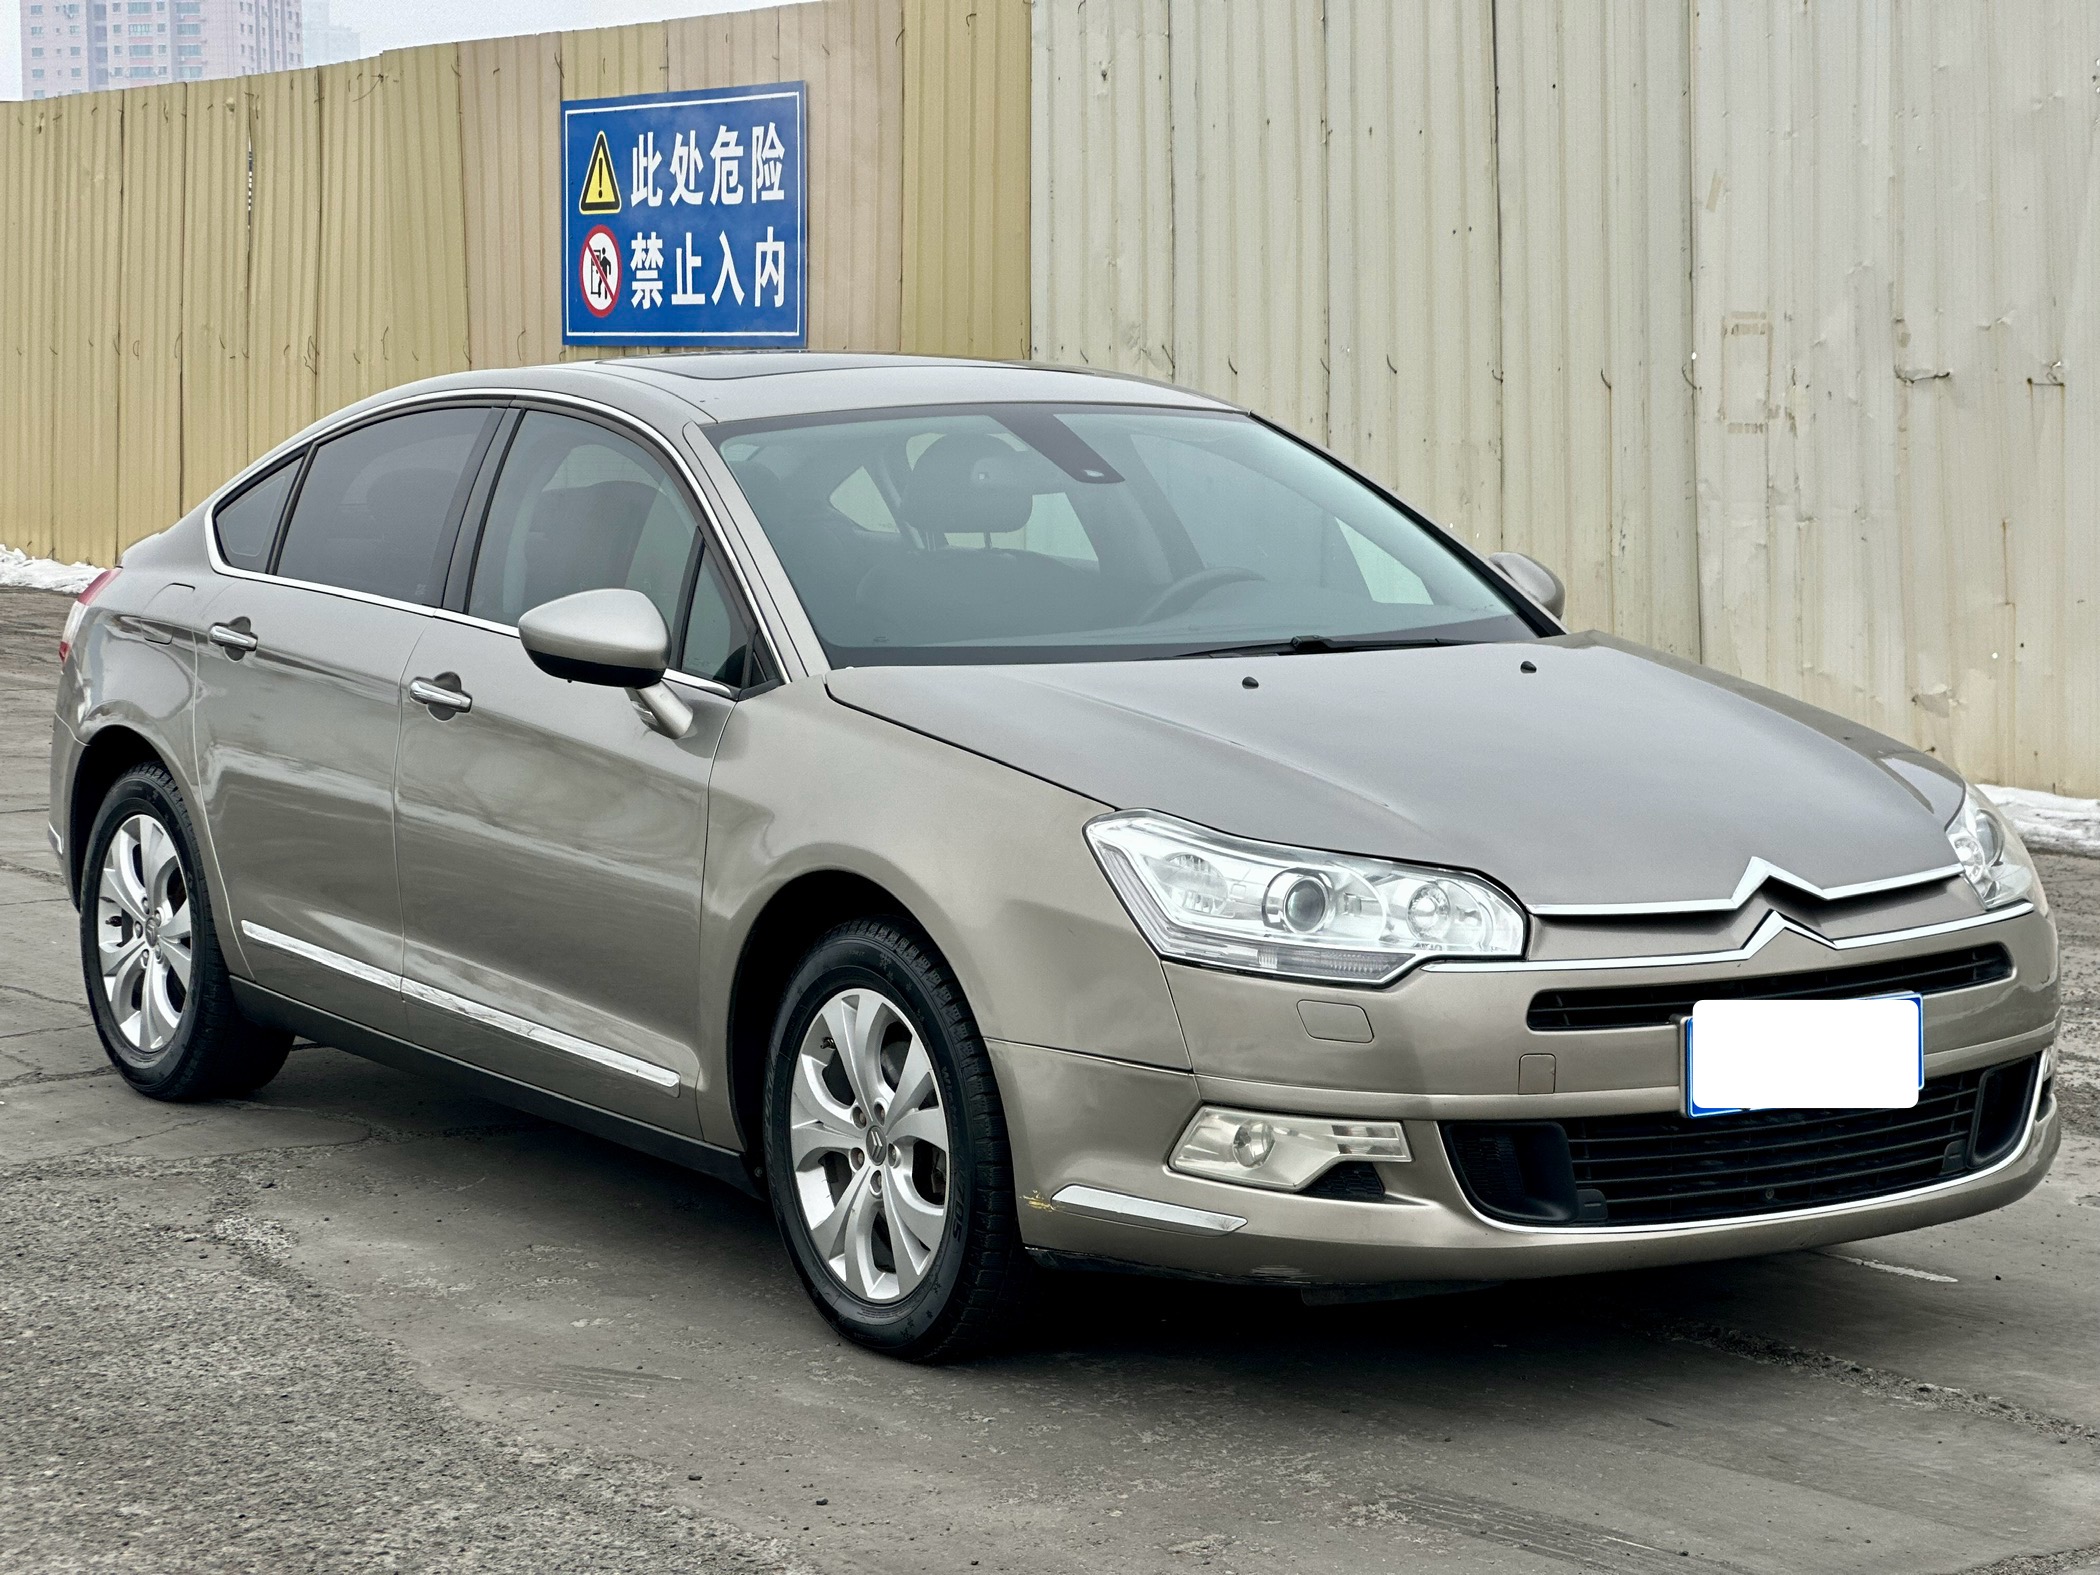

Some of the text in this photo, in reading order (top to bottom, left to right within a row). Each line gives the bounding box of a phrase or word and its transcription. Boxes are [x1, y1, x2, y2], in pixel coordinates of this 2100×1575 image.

[630, 121, 786, 208] 此处危险
[630, 226, 786, 310] 禁止入内
